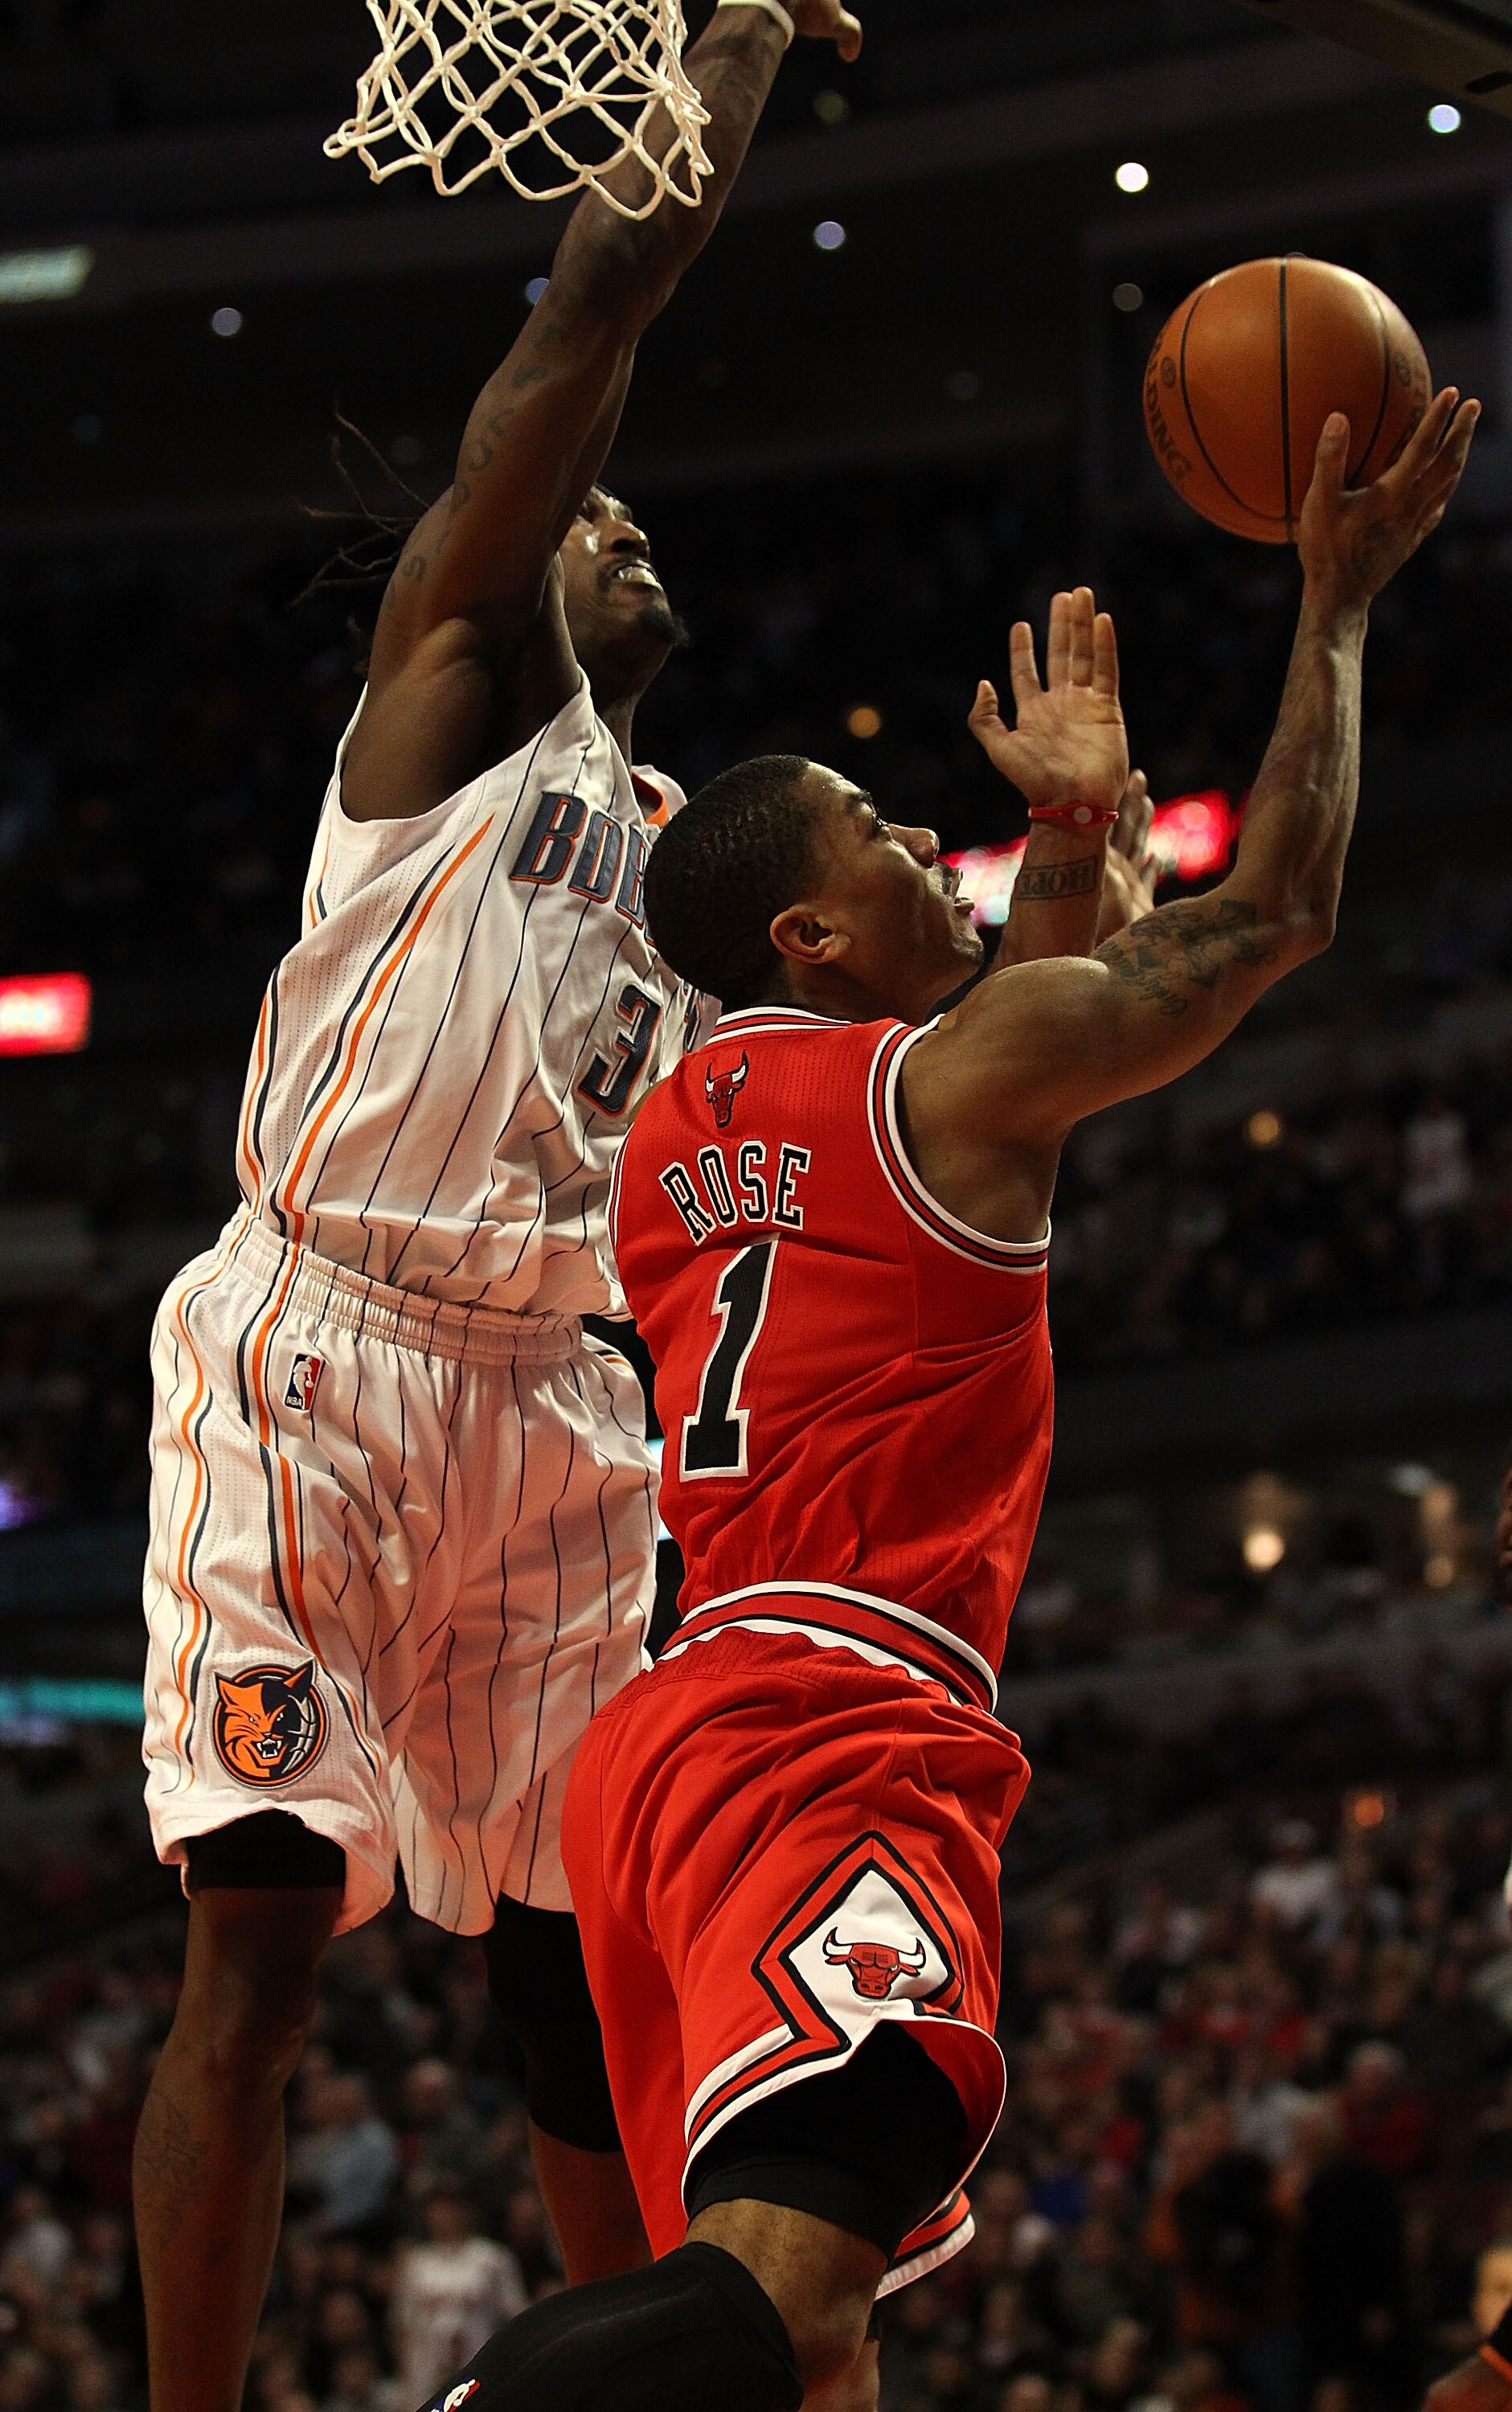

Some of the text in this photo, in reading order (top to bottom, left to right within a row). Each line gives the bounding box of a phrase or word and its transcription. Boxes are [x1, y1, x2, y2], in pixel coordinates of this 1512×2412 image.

[510, 791, 656, 947] BOB
[576, 981, 662, 1118] 3
[658, 1140, 812, 1246] ROSE
[286, 1396, 302, 1407] NBA
[679, 1232, 781, 1483] 1
